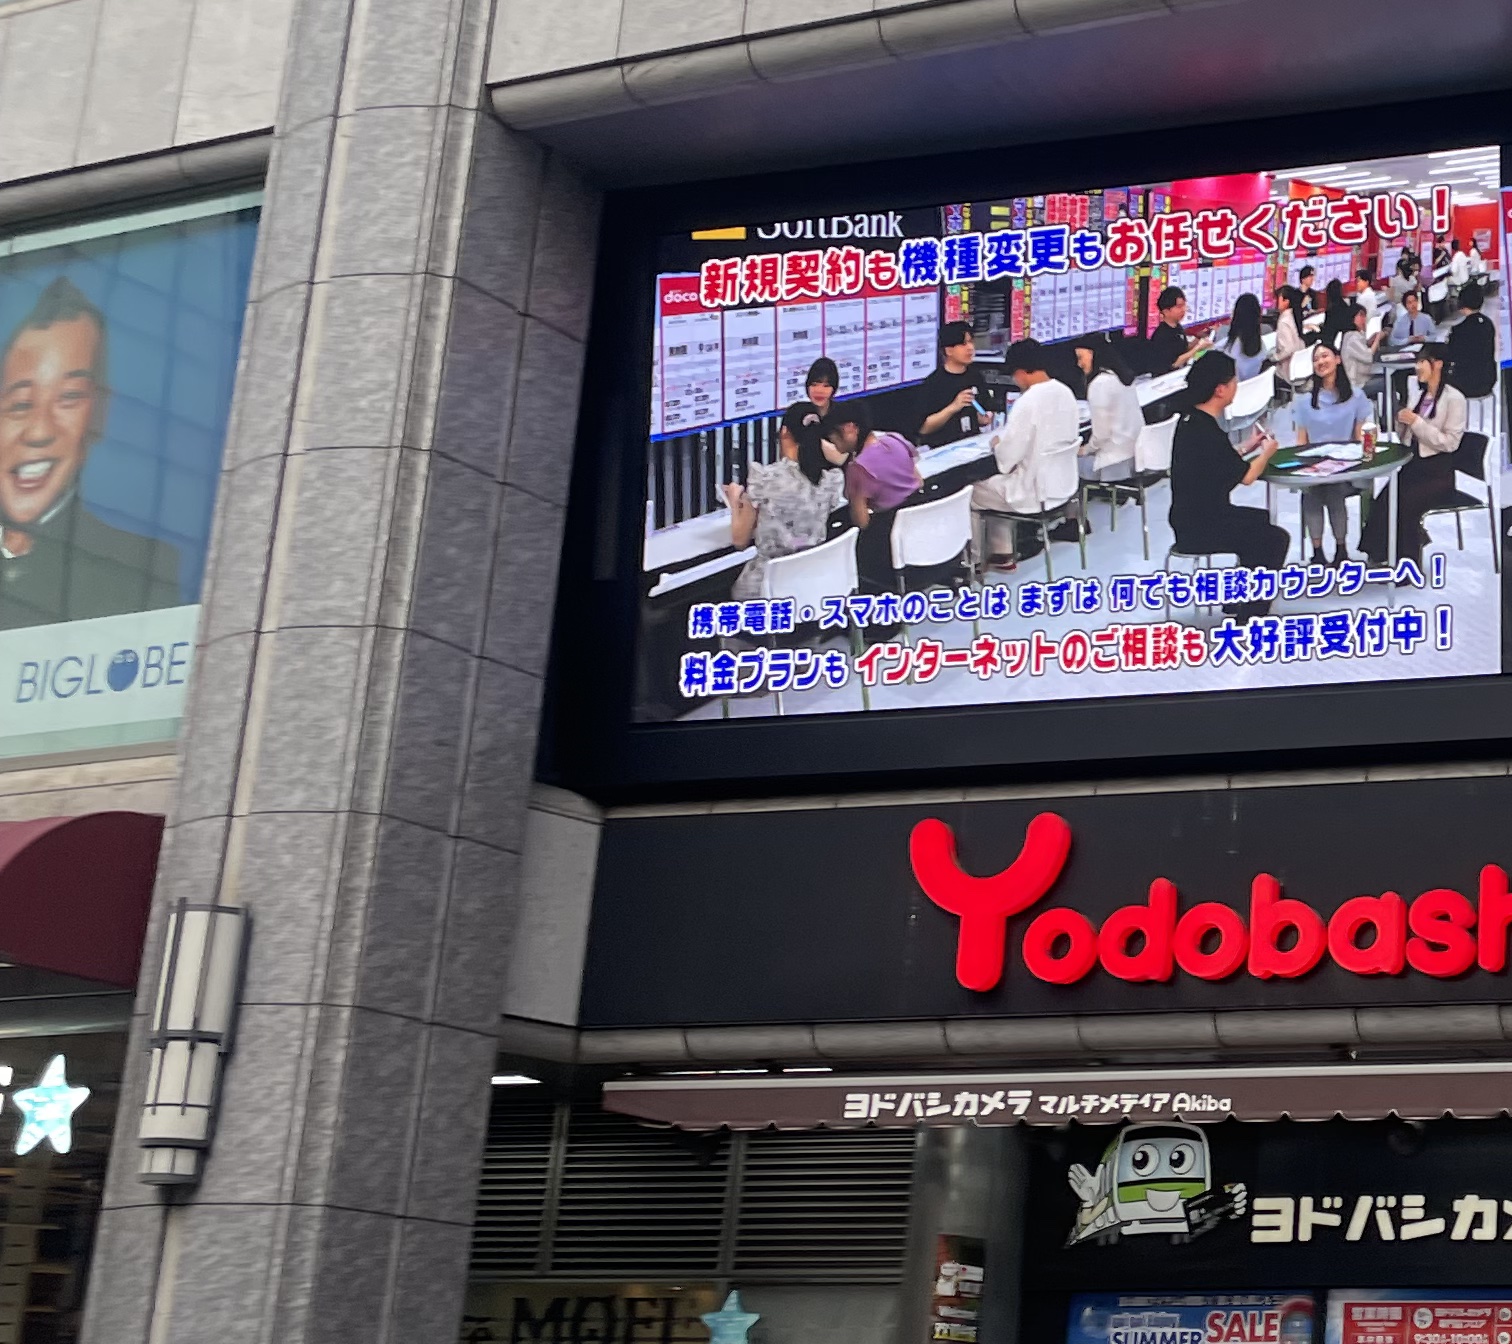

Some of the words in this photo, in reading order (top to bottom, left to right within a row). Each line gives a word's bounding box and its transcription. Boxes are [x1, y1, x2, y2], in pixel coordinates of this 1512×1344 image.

[843, 1090, 1033, 1119] ヨドバシカメラ
[1038, 1092, 1171, 1115] マルチメディア
[1171, 1092, 1232, 1113] Akiba
[1206, 1311, 1280, 1343] SALE
